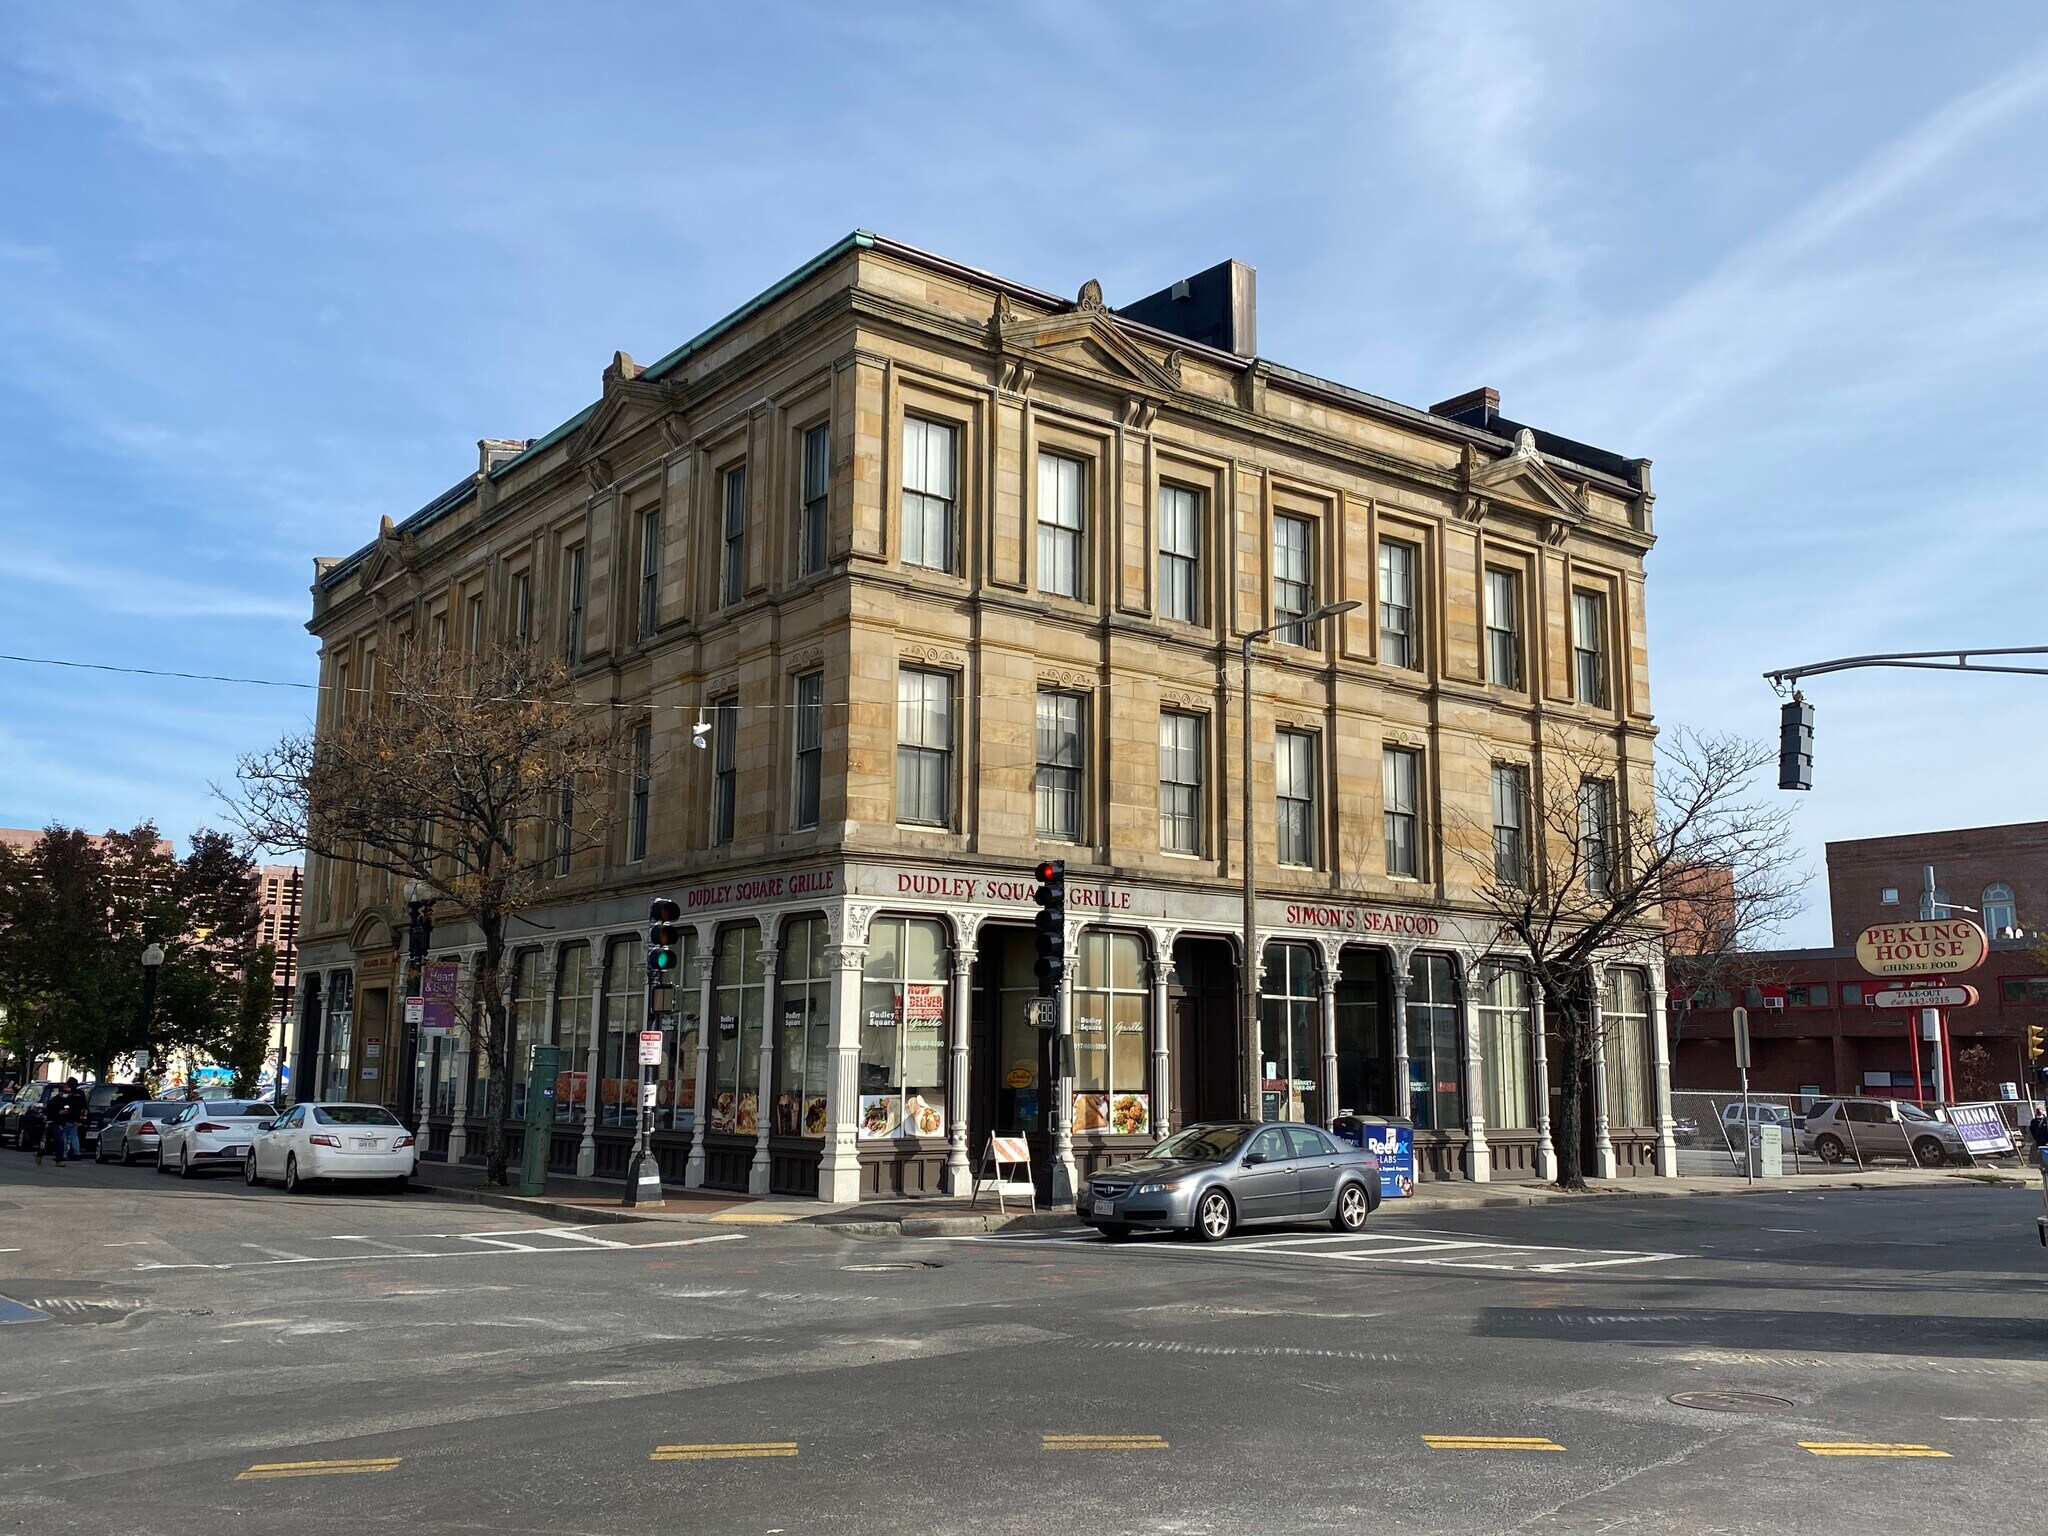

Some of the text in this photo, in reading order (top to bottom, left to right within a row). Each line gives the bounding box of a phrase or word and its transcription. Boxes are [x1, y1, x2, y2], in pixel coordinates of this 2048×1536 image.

[688, 871, 834, 907] DUDLEY SQUARE GRILLE
[898, 873, 1131, 909] DUDLEY SQUA GRILLE
[1286, 905, 1439, 935] SIMON'S SEAFOOD
[1866, 923, 1971, 945] PEKING
[1875, 941, 1965, 961] HOUSE
[1883, 961, 1958, 972] CHINESE FOOD
[430, 970, 455, 981] Heart
[425, 982, 432, 992] &
[1896, 989, 1942, 998] TAKE-OUT
[909, 995, 943, 1007] DELIVER
[1908, 996, 1950, 1005] 442-9215
[869, 1010, 895, 1020] Dudley
[1080, 1016, 1102, 1025] Dudley
[869, 1019, 896, 1027] Square
[908, 1016, 943, 1030] Grille
[1114, 1021, 1144, 1035] Grille
[1953, 1106, 1998, 1126] AYANNA
[1959, 1122, 2002, 1140] PRESSLEY
[1379, 1155, 1397, 1163] LABS
